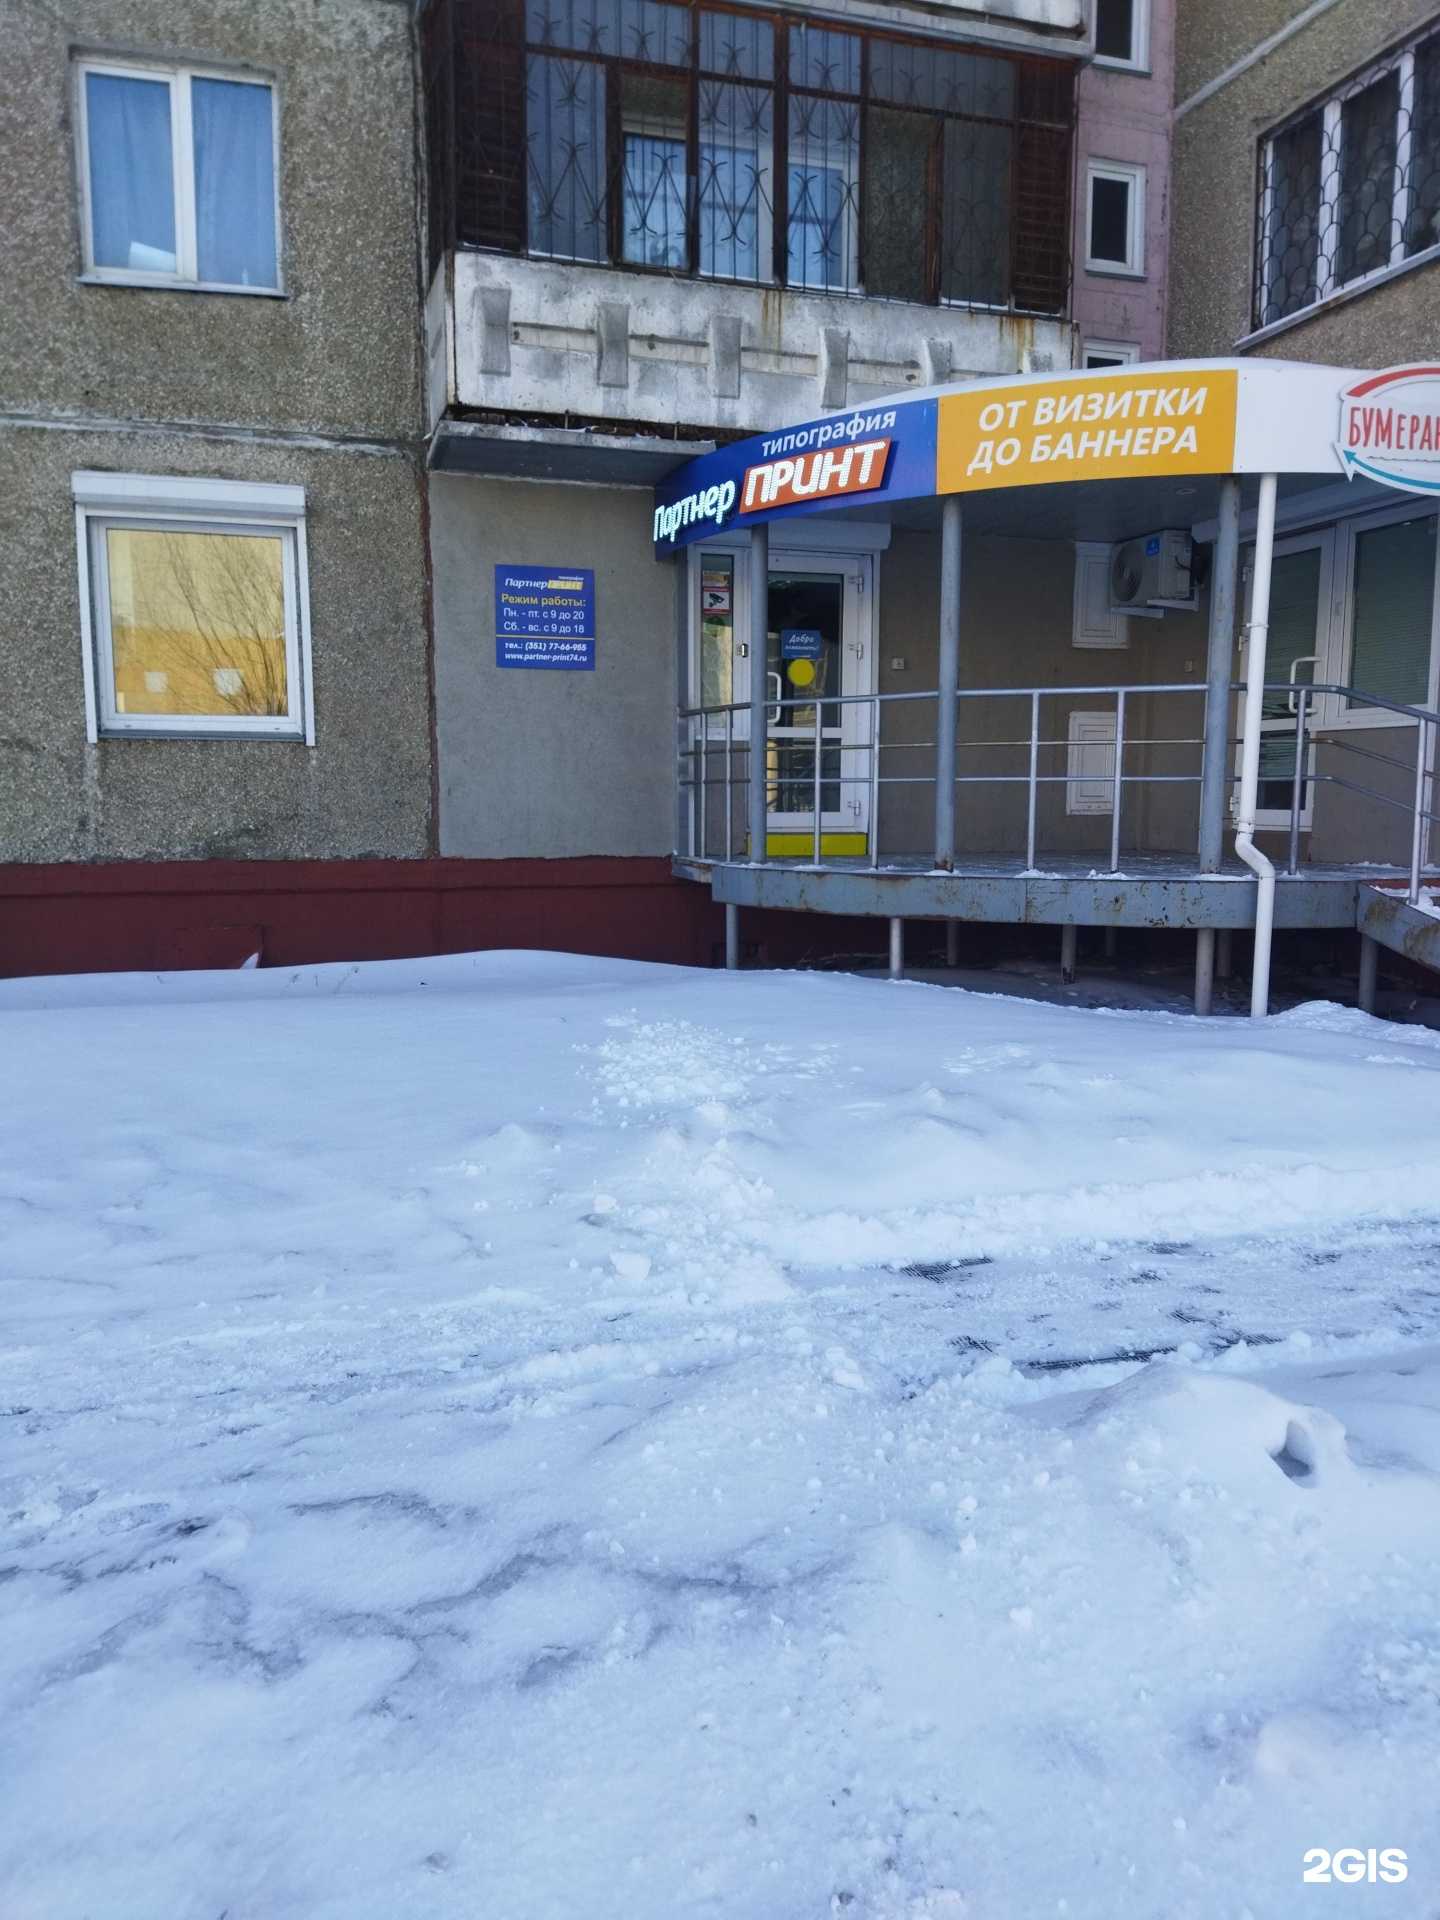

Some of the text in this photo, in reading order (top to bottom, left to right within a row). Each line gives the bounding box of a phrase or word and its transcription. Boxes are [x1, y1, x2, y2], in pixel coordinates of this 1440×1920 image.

[979, 387, 1207, 431] ОТ ВИЗИТКИ
[762, 411, 896, 456] типография
[966, 426, 1198, 476] ДО БАННЕРА
[654, 441, 887, 542] Партнер ПРИНТ
[505, 578, 547, 590] Партнер
[501, 593, 586, 607] Режим работы:
[503, 608, 519, 617] Пн.
[528, 610, 540, 618] пт.
[550, 610, 557, 618] 9
[559, 611, 571, 621] до
[573, 611, 585, 620] 20
[503, 621, 520, 631] Сб.
[528, 624, 541, 632] вс.
[551, 624, 557, 632] 9
[559, 625, 571, 635] до
[574, 625, 585, 633] 18
[525, 642, 546, 651] (351)
[505, 653, 587, 662] www.partner-print74.ru
